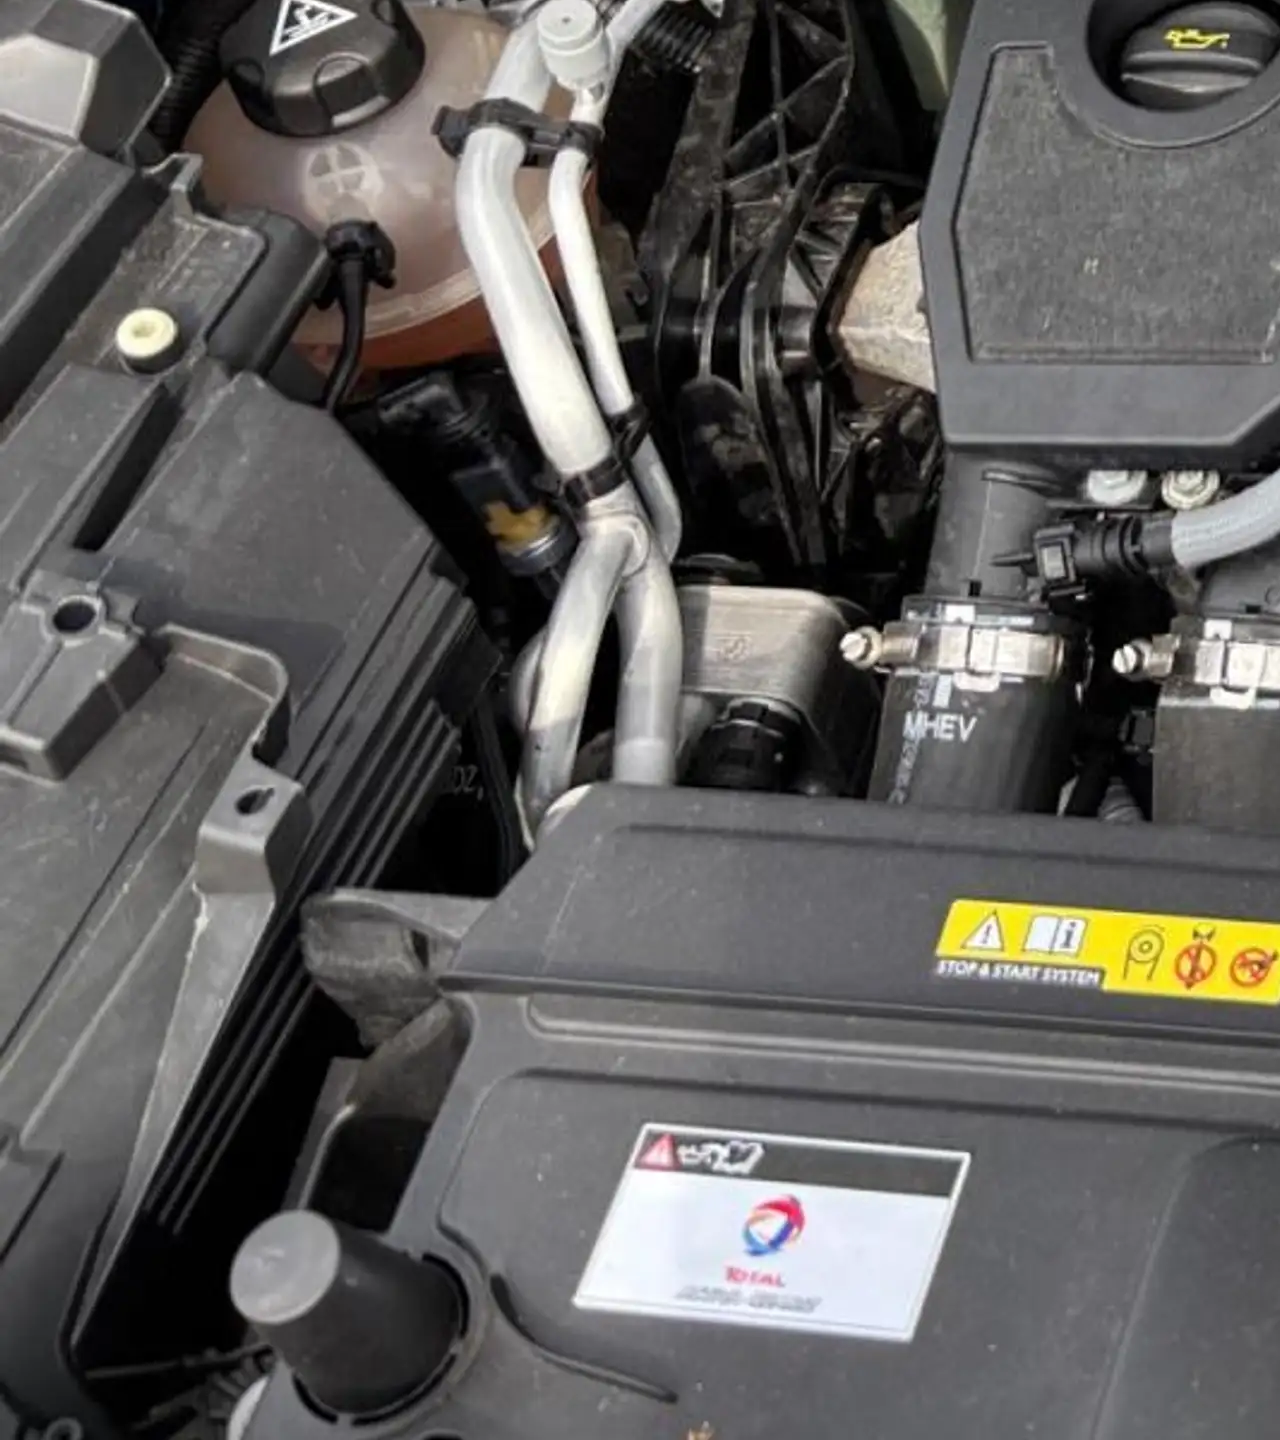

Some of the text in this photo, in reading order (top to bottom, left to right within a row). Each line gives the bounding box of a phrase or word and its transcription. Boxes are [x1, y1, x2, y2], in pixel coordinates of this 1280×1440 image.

[903, 710, 978, 743] MHEV
[935, 959, 1100, 987] STOP & START SYSTEM
[724, 1265, 786, 1288] TOTAL
